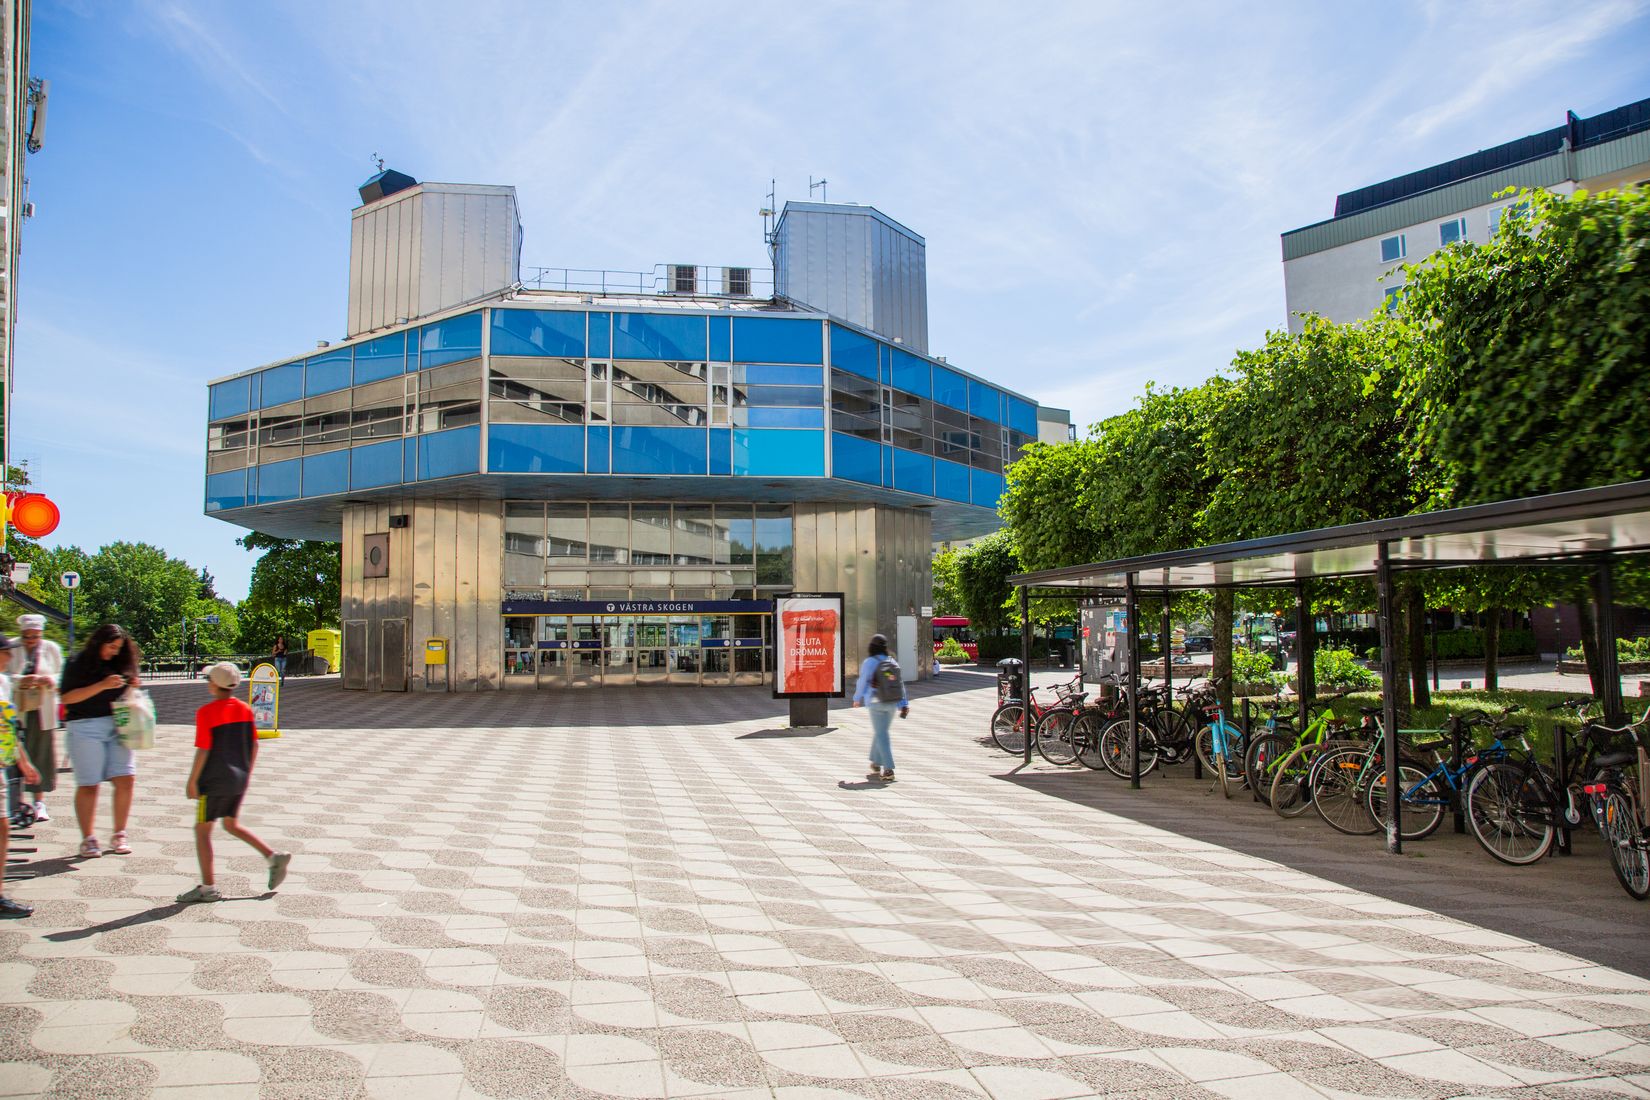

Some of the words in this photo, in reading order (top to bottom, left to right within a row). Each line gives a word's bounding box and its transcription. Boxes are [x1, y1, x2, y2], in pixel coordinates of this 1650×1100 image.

[619, 602, 654, 611] VÄSTRA
[657, 603, 694, 611] SKOGEN
[796, 637, 821, 646] SLUTA
